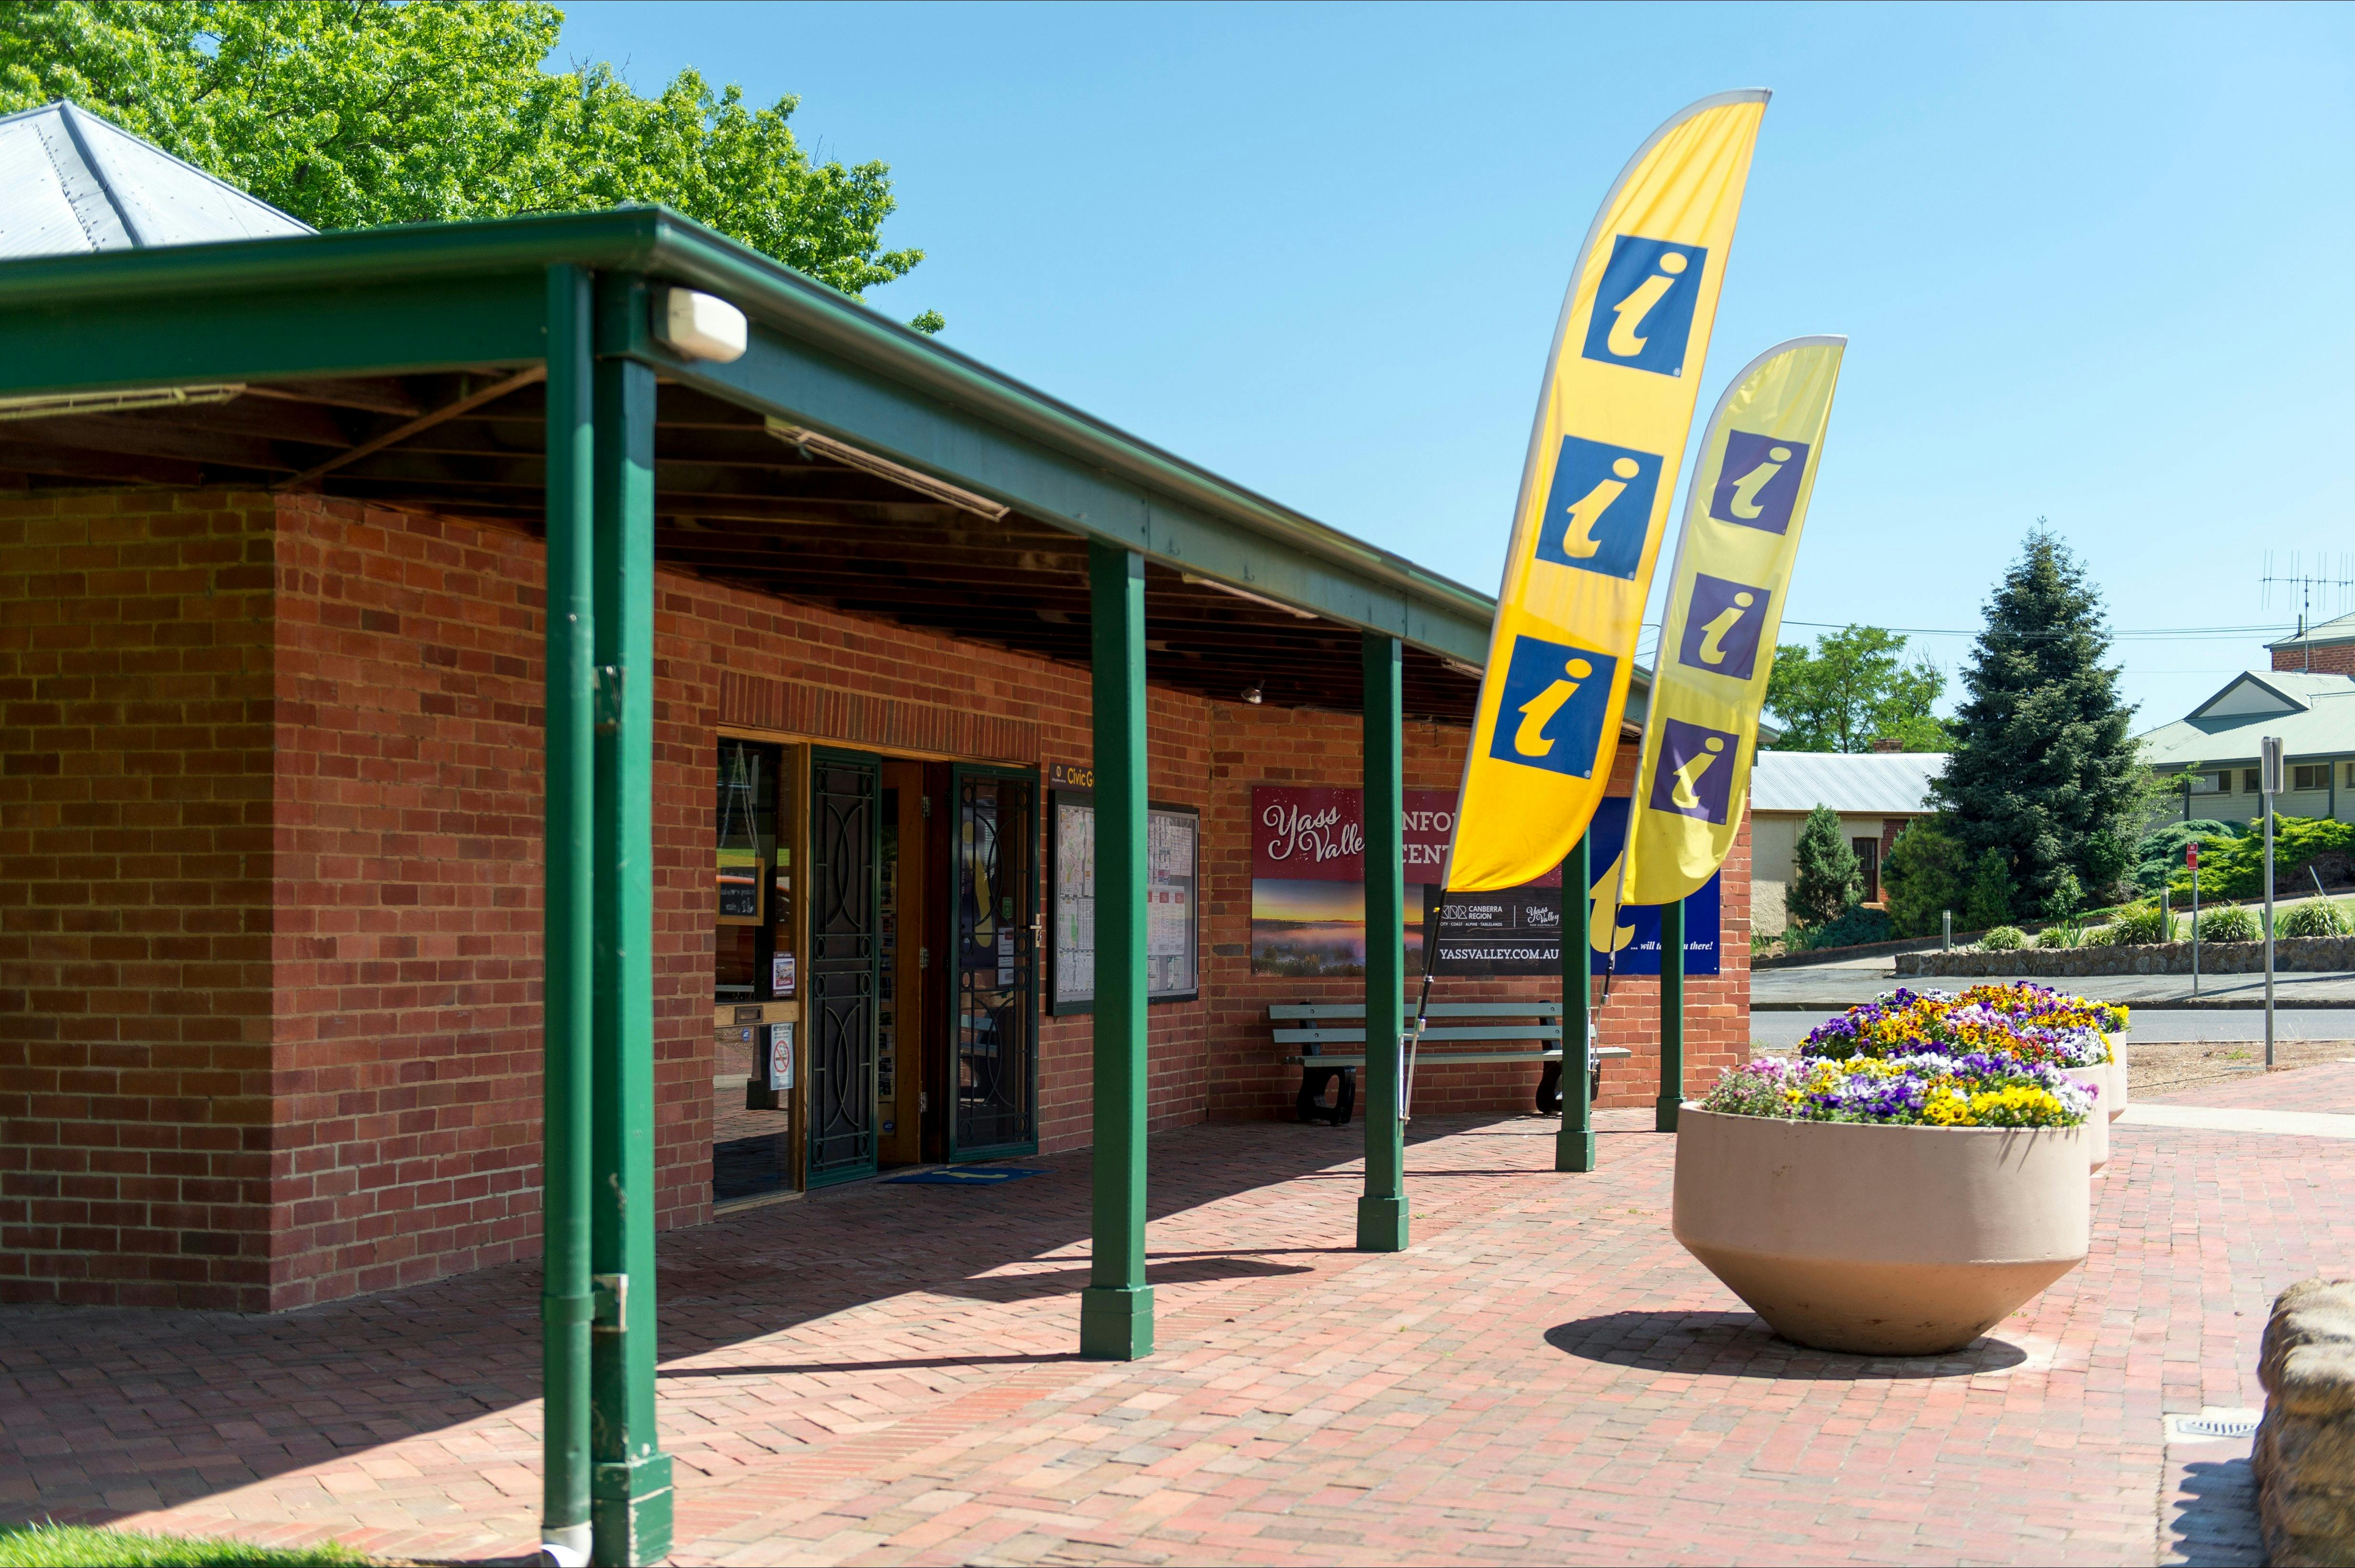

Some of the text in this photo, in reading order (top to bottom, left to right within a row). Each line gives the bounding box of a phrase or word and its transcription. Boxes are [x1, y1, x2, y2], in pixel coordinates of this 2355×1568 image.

[1608, 253, 1687, 356] i
[1731, 448, 1791, 518] i
[1563, 458, 1639, 558] i
[1699, 592, 1753, 664] i
[1514, 658, 1592, 757] i
[1067, 767, 1086, 786] Civic
[1672, 737, 1724, 808] i
[1263, 804, 1341, 859] Yass
[1298, 823, 1365, 862] Valle
[1402, 811, 1456, 831] NFO
[1526, 906, 1548, 923] Yass
[1536, 912, 1559, 925] Valley
[1439, 949, 1559, 959] YASSVALLEY.COM.AU
[1641, 941, 1655, 950] will
[1690, 942, 1713, 950] there!
